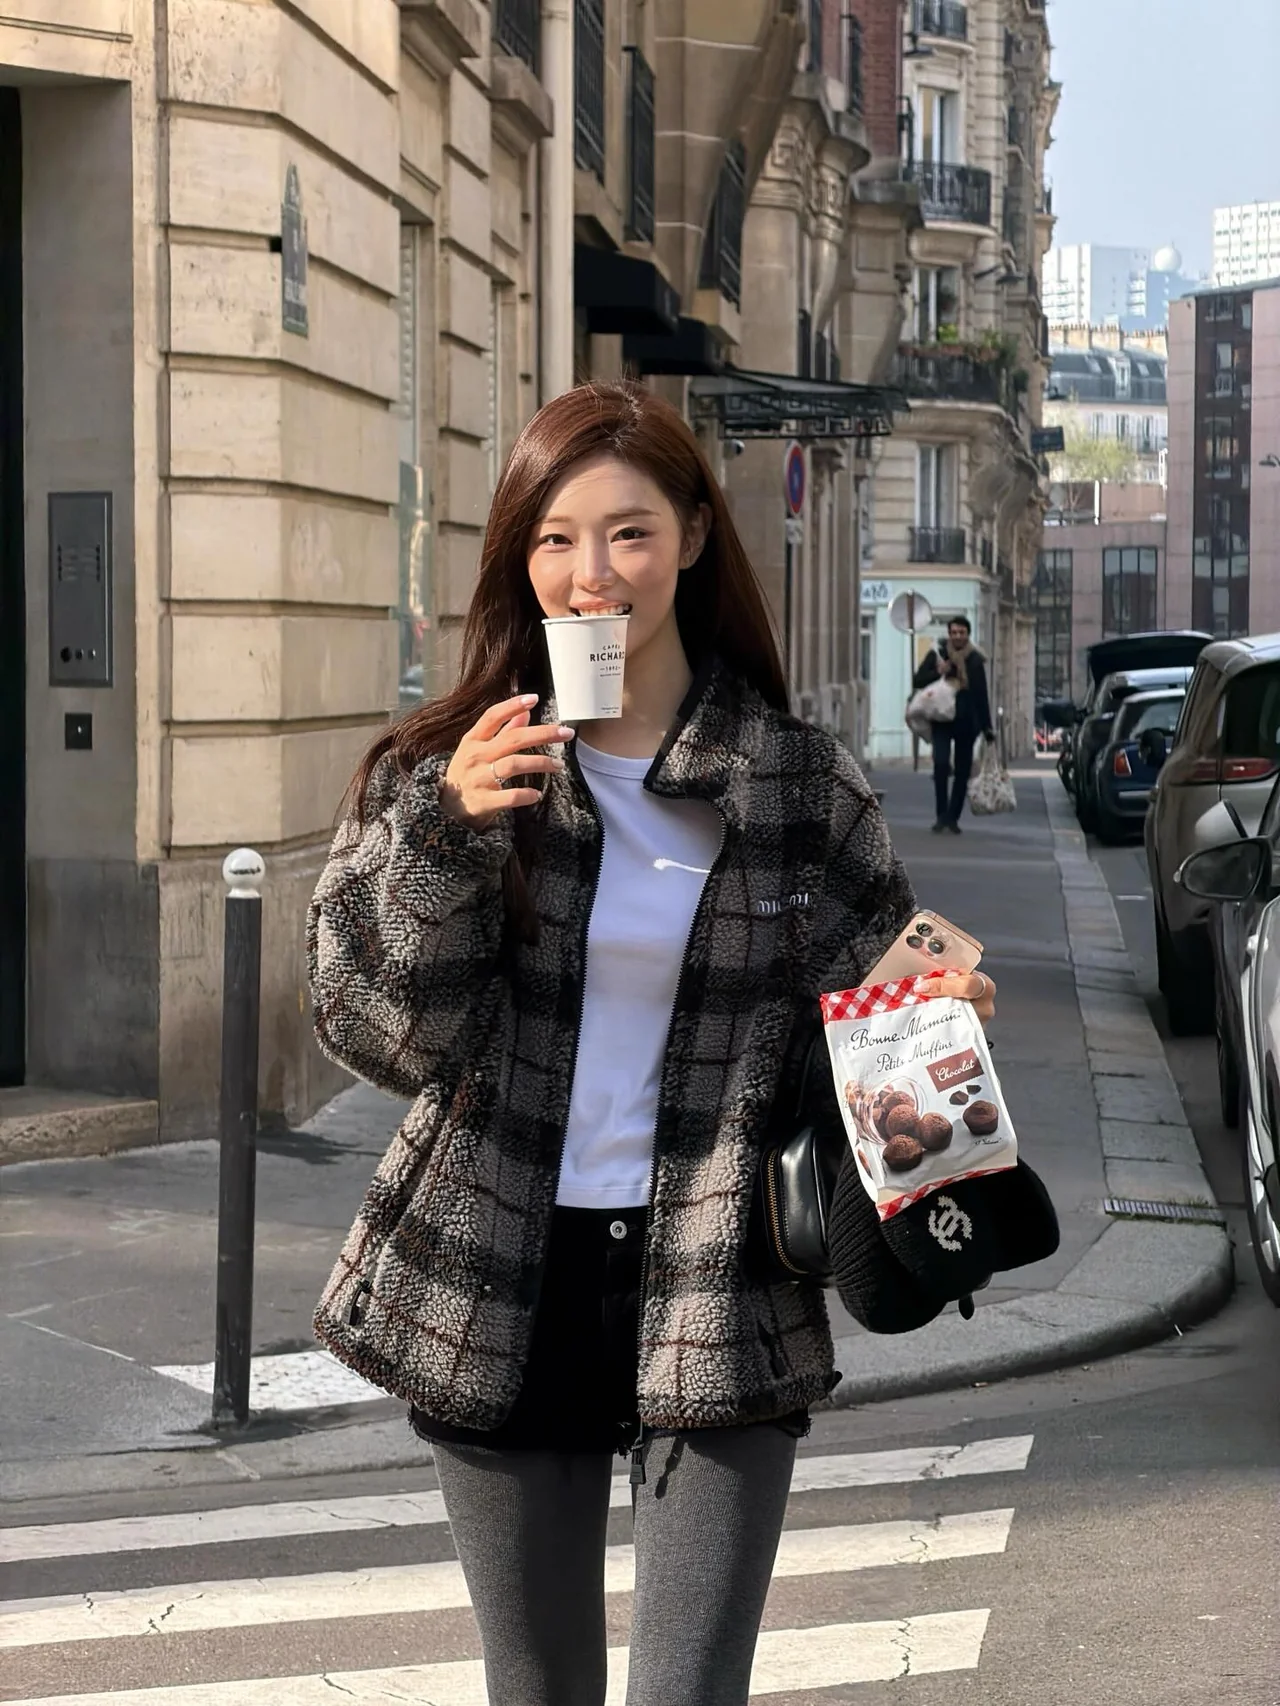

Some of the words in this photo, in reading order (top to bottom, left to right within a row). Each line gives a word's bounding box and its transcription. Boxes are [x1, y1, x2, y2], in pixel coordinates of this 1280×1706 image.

[851, 1029, 899, 1050] Bonne
[877, 1054, 904, 1072] Petits
[908, 1040, 953, 1063] Muffins
[936, 1059, 975, 1081] Chocolat
